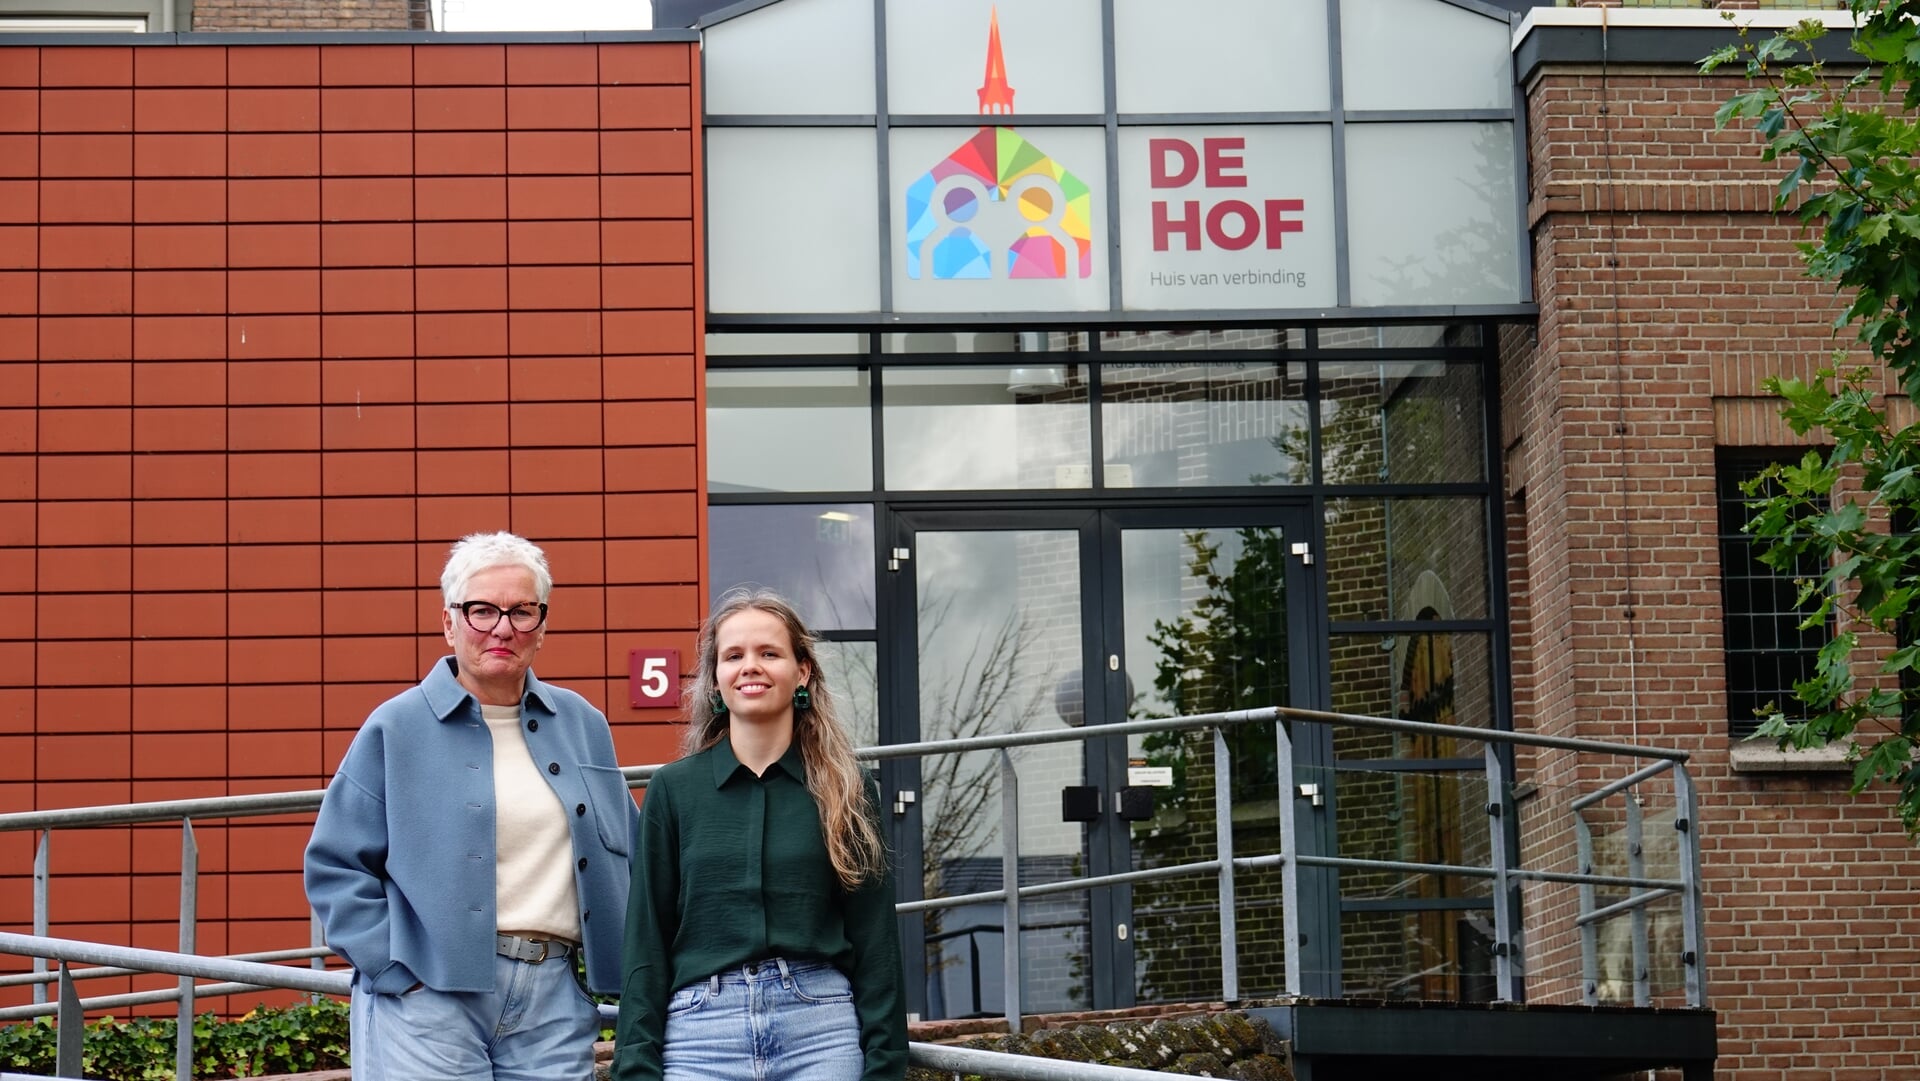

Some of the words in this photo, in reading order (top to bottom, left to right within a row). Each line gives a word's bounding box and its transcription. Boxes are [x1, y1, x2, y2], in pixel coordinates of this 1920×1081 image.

[1149, 137, 1248, 189] DE
[1151, 199, 1305, 252] HOF
[1150, 271, 1186, 286] Huis
[1190, 273, 1218, 286] van
[1222, 268, 1306, 288] verbinding
[640, 657, 669, 698] 5
